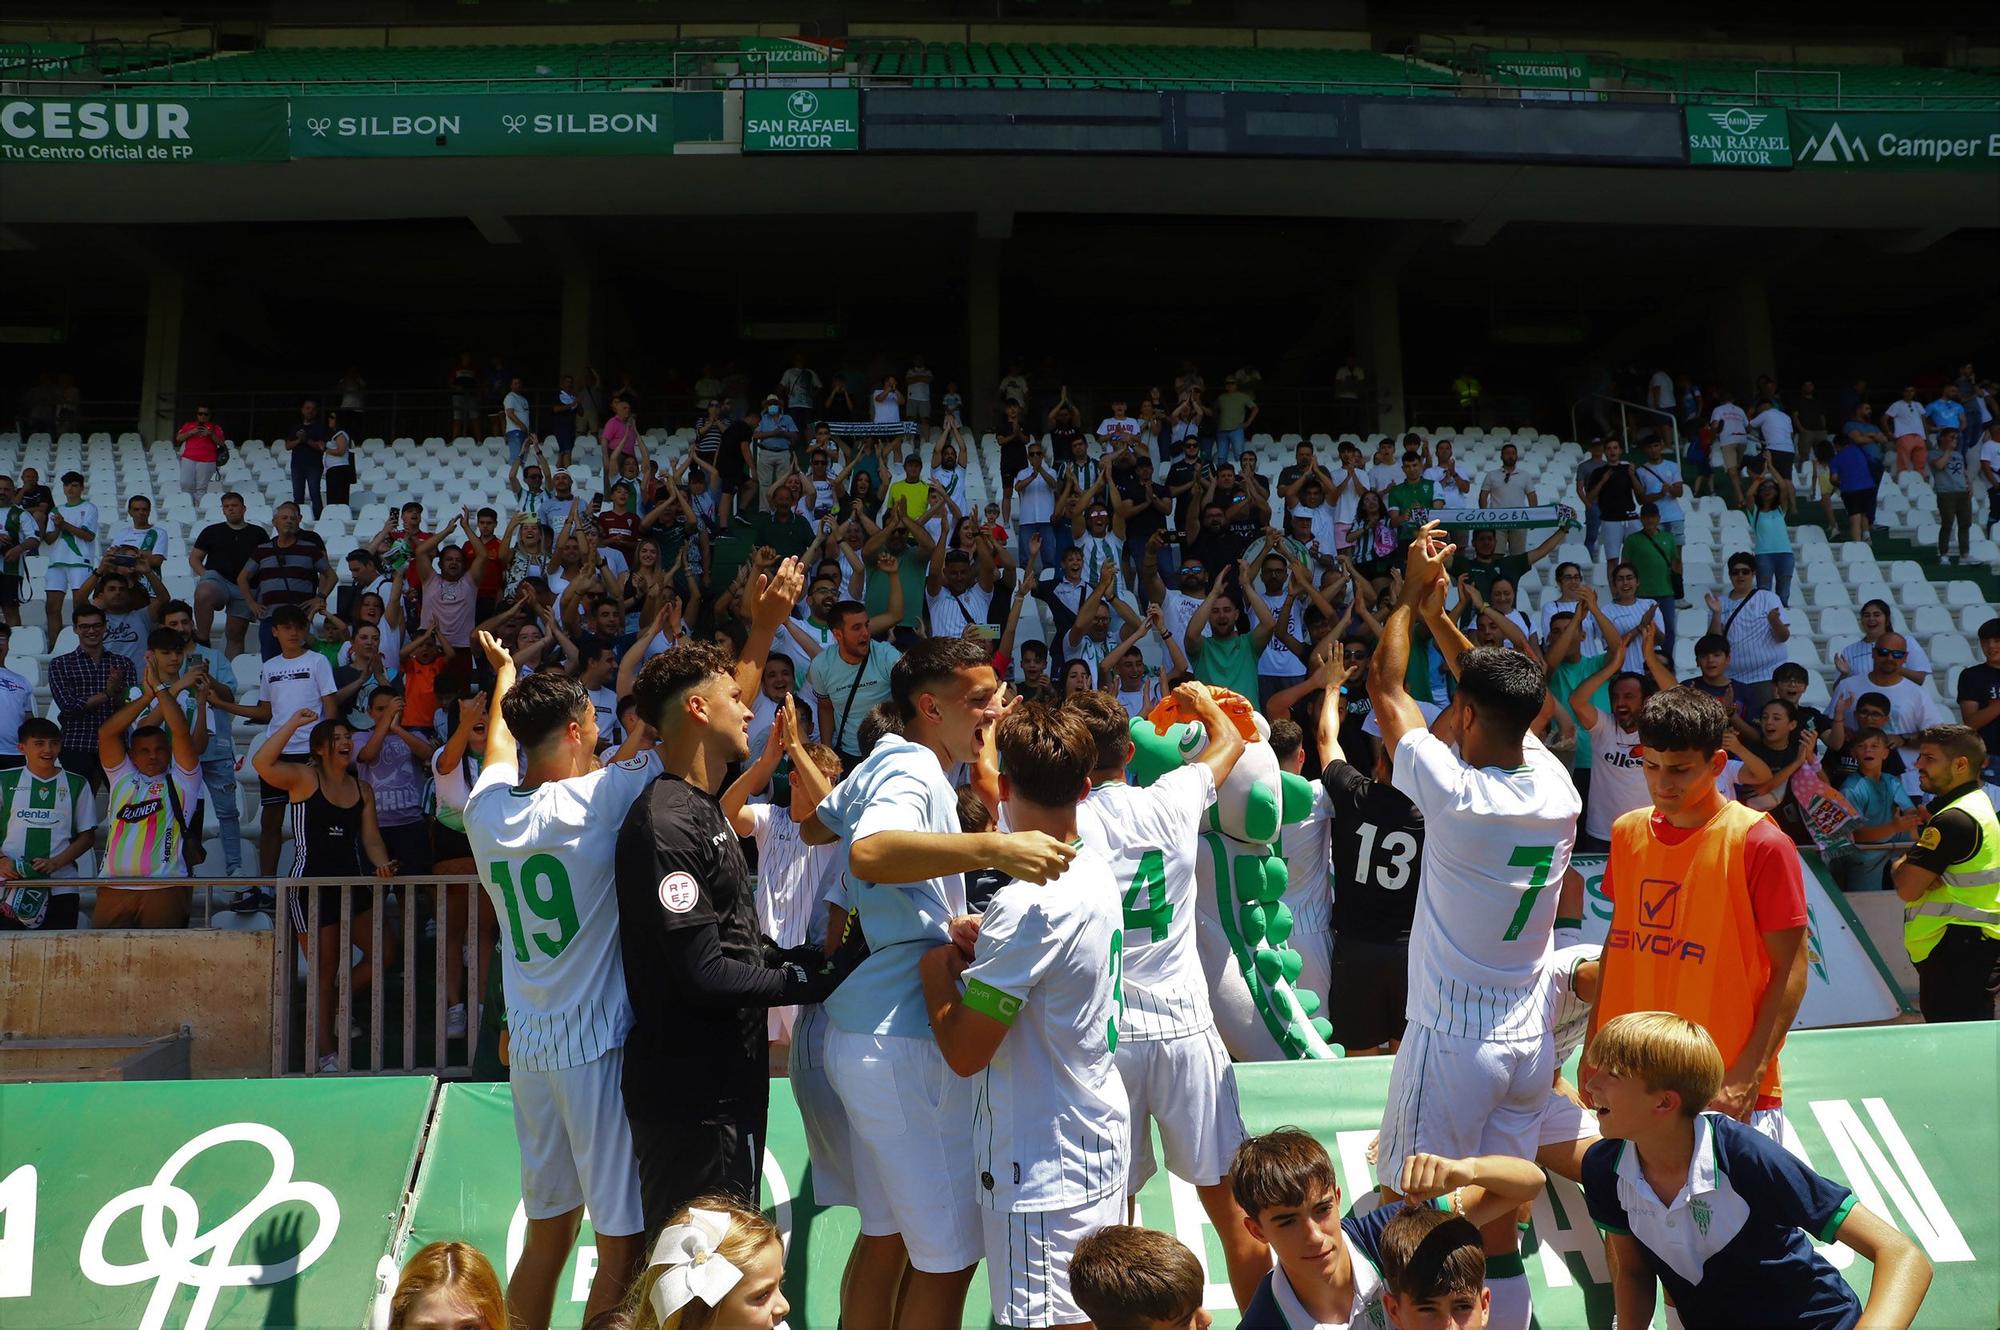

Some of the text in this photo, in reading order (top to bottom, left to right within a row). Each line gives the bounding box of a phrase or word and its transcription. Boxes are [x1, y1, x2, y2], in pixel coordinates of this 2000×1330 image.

[1, 101, 190, 140] CESUR
[338, 115, 460, 137] SILBON
[534, 113, 657, 134] SILBON
[747, 119, 856, 133] SAN RAFAEL
[1728, 116, 1749, 126] MINI
[769, 134, 833, 148] MOTOR
[1690, 135, 1790, 151] SAN RAFAEL
[1877, 133, 1981, 162] Camper
[2, 144, 193, 160] Tu Centro Oficial de FP
[1712, 149, 1772, 165] MOTOR
[1456, 510, 1530, 521] CÓRDOBA
[1354, 821, 1418, 890] 13
[1123, 849, 1175, 944] 4
[1502, 846, 1554, 941] 7
[490, 853, 580, 962] 19
[1610, 928, 1706, 965] GIVOVA
[998, 996, 1017, 1017] C
